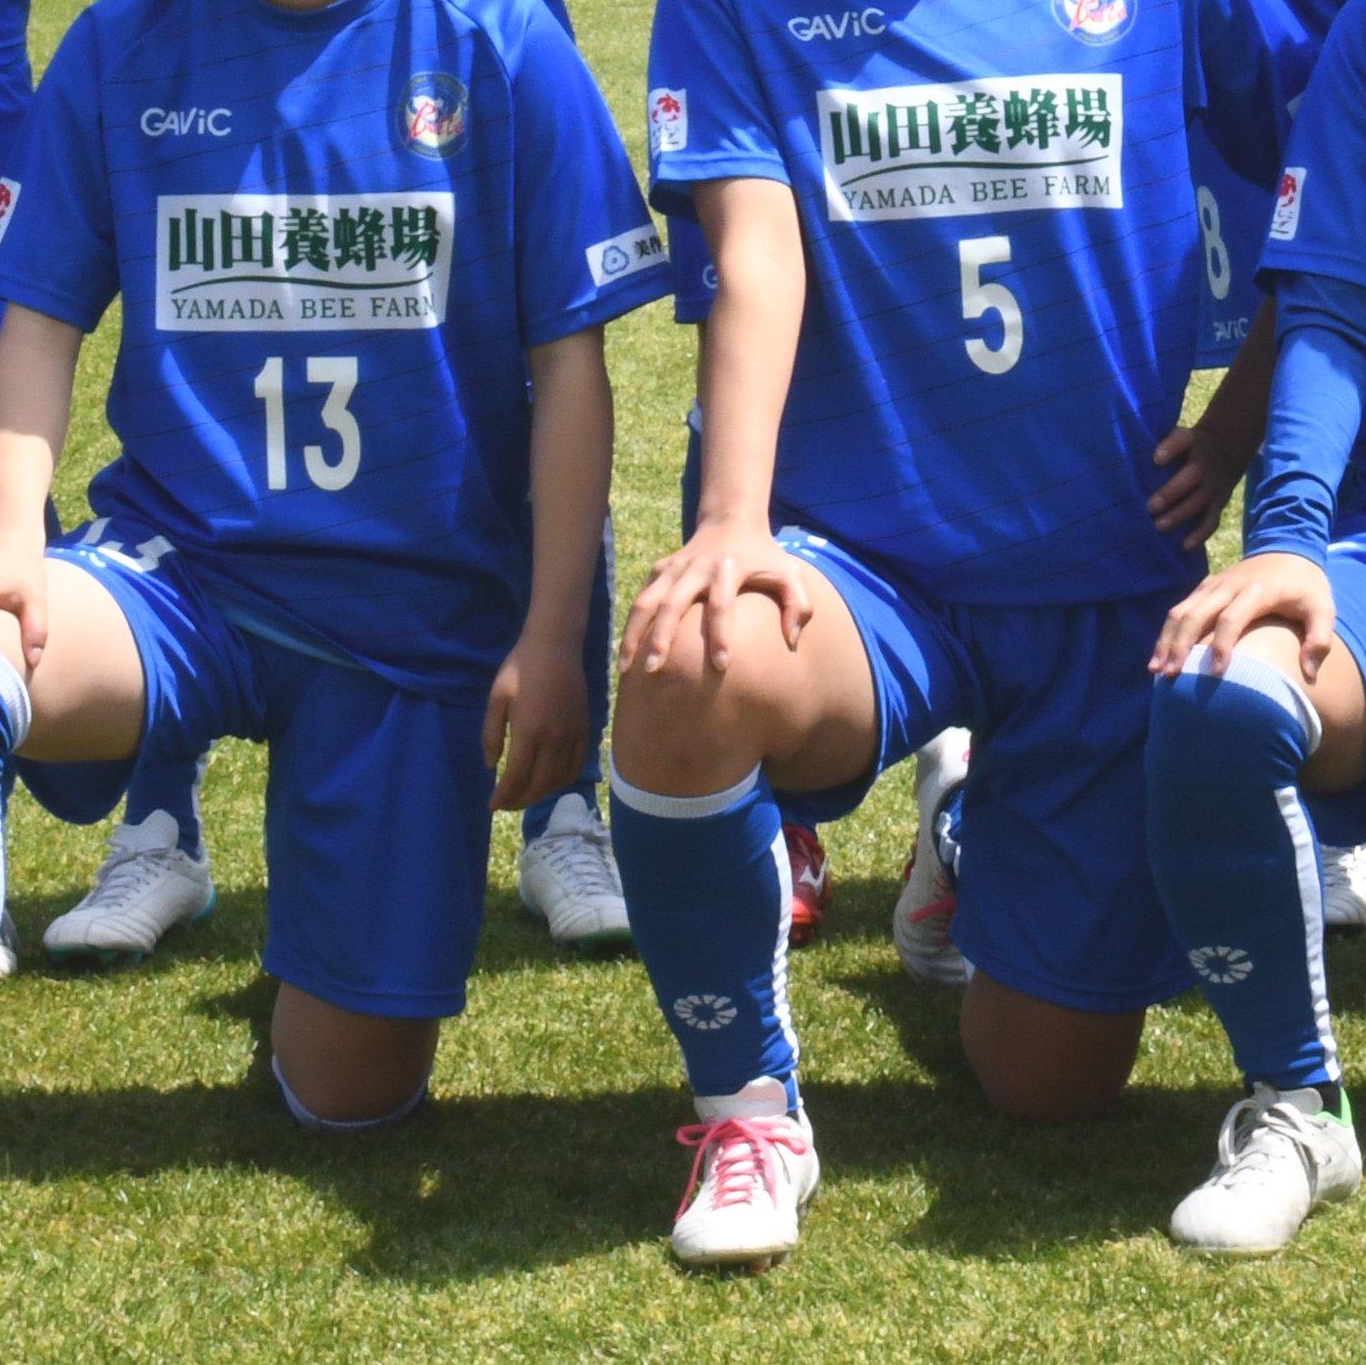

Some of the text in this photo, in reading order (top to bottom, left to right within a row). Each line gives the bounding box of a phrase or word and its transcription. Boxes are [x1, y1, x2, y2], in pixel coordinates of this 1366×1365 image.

[828, 87, 1113, 165] 山田養蜂場
[843, 176, 1111, 213] YAMADA BEE FARM
[168, 205, 442, 273] 山田養蜂場
[1197, 185, 1231, 300] 8
[171, 292, 436, 321] YAMADA BEE FARM
[958, 235, 1024, 375] 5
[253, 356, 363, 492] 13
